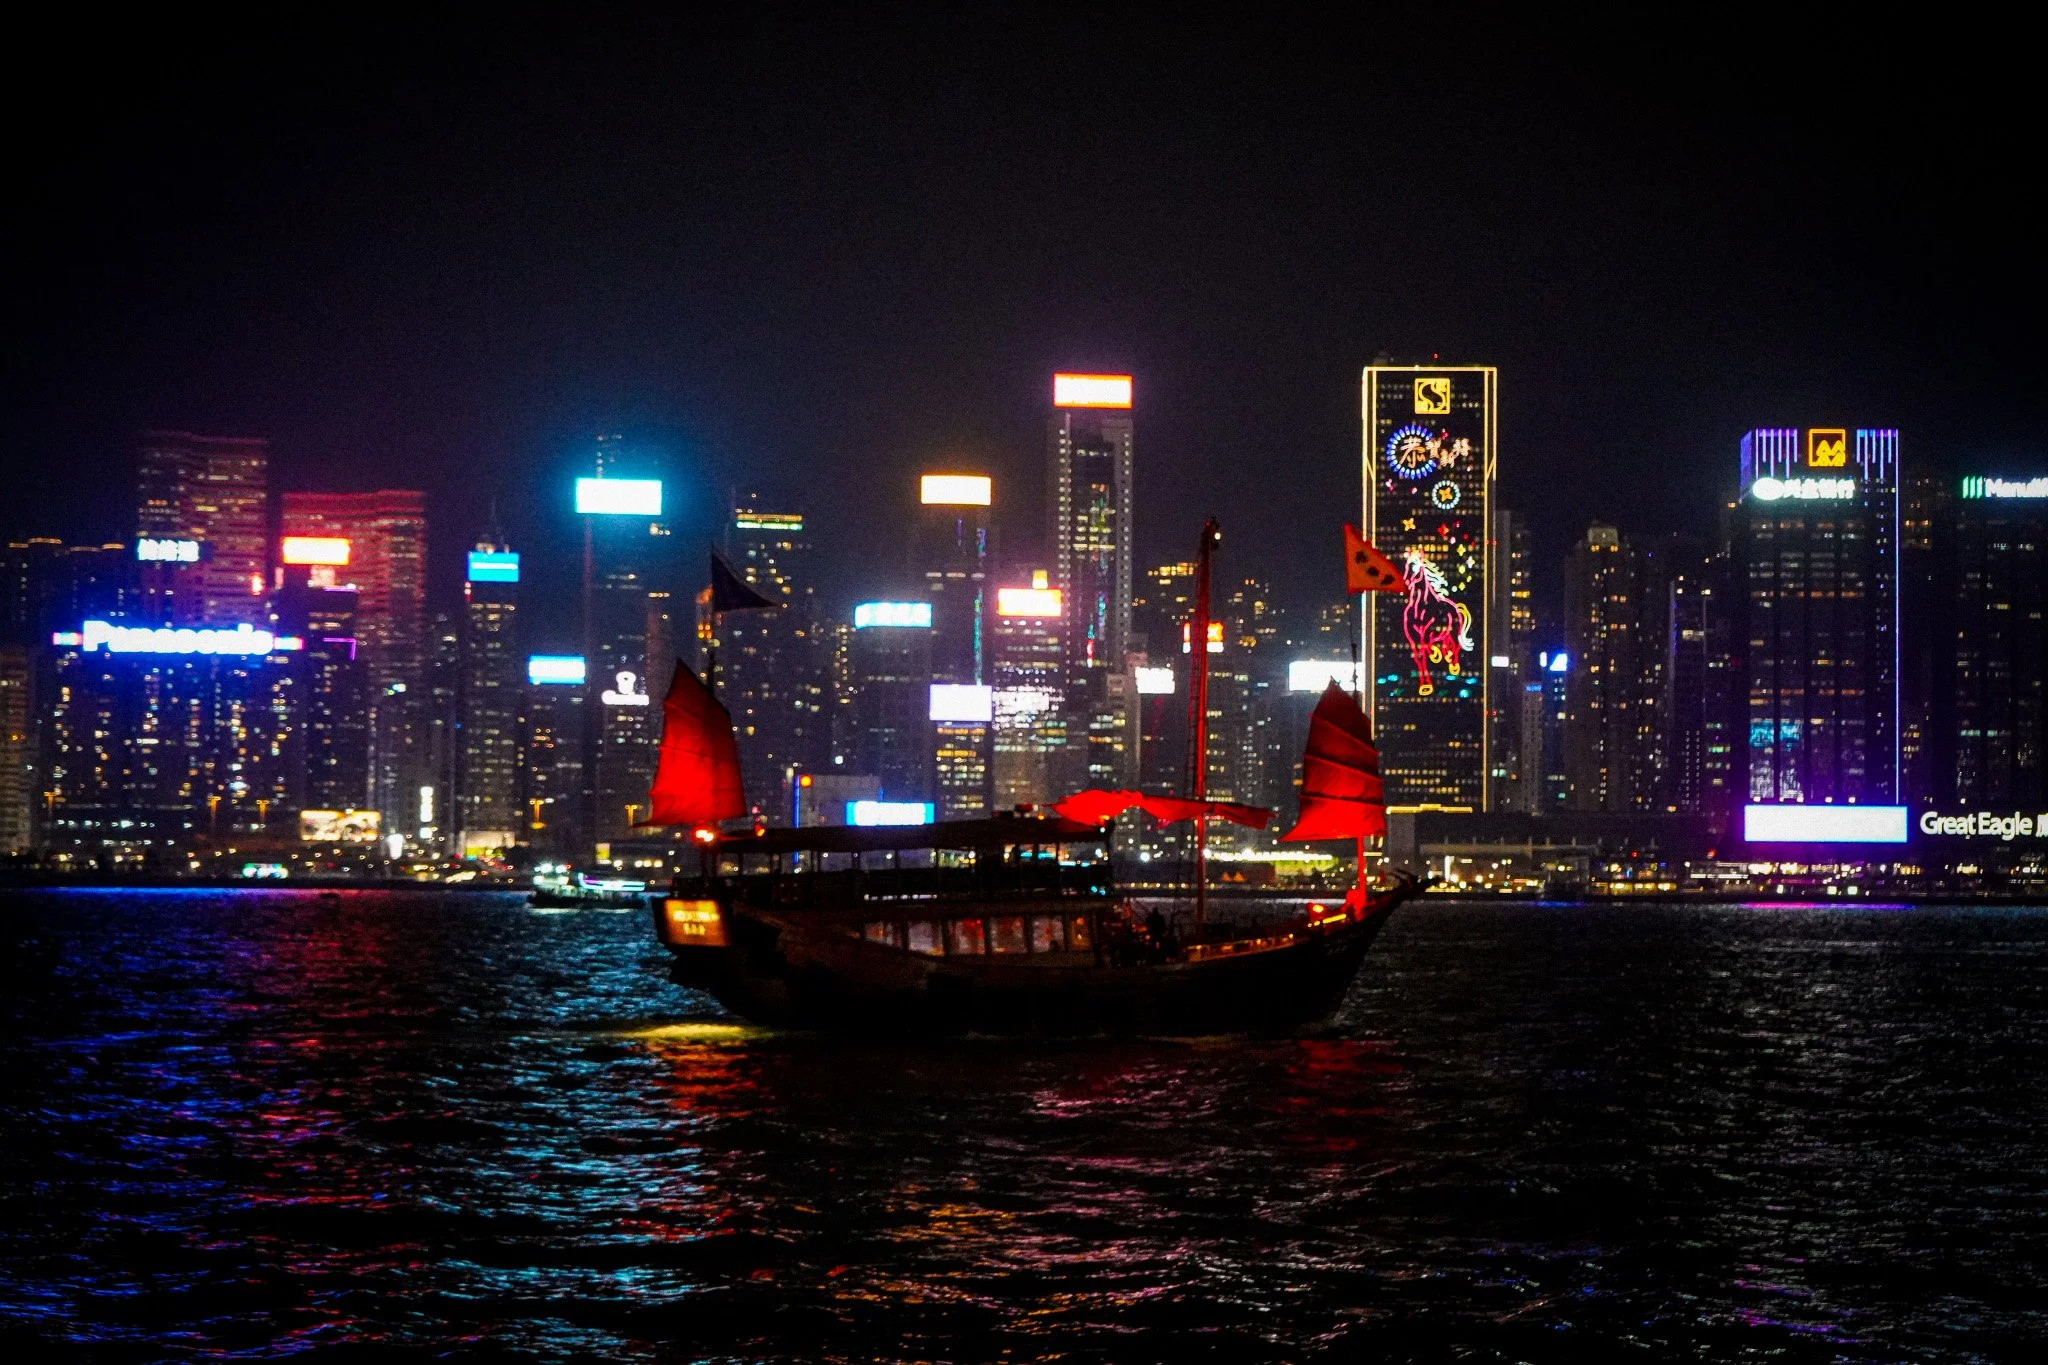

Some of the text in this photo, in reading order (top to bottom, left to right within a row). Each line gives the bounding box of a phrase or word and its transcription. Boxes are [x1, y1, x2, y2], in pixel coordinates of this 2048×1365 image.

[1985, 477, 2048, 498] Manulif
[83, 620, 274, 655] Panasonic
[1920, 811, 1976, 835] Great
[1978, 811, 2033, 841] Eagle
